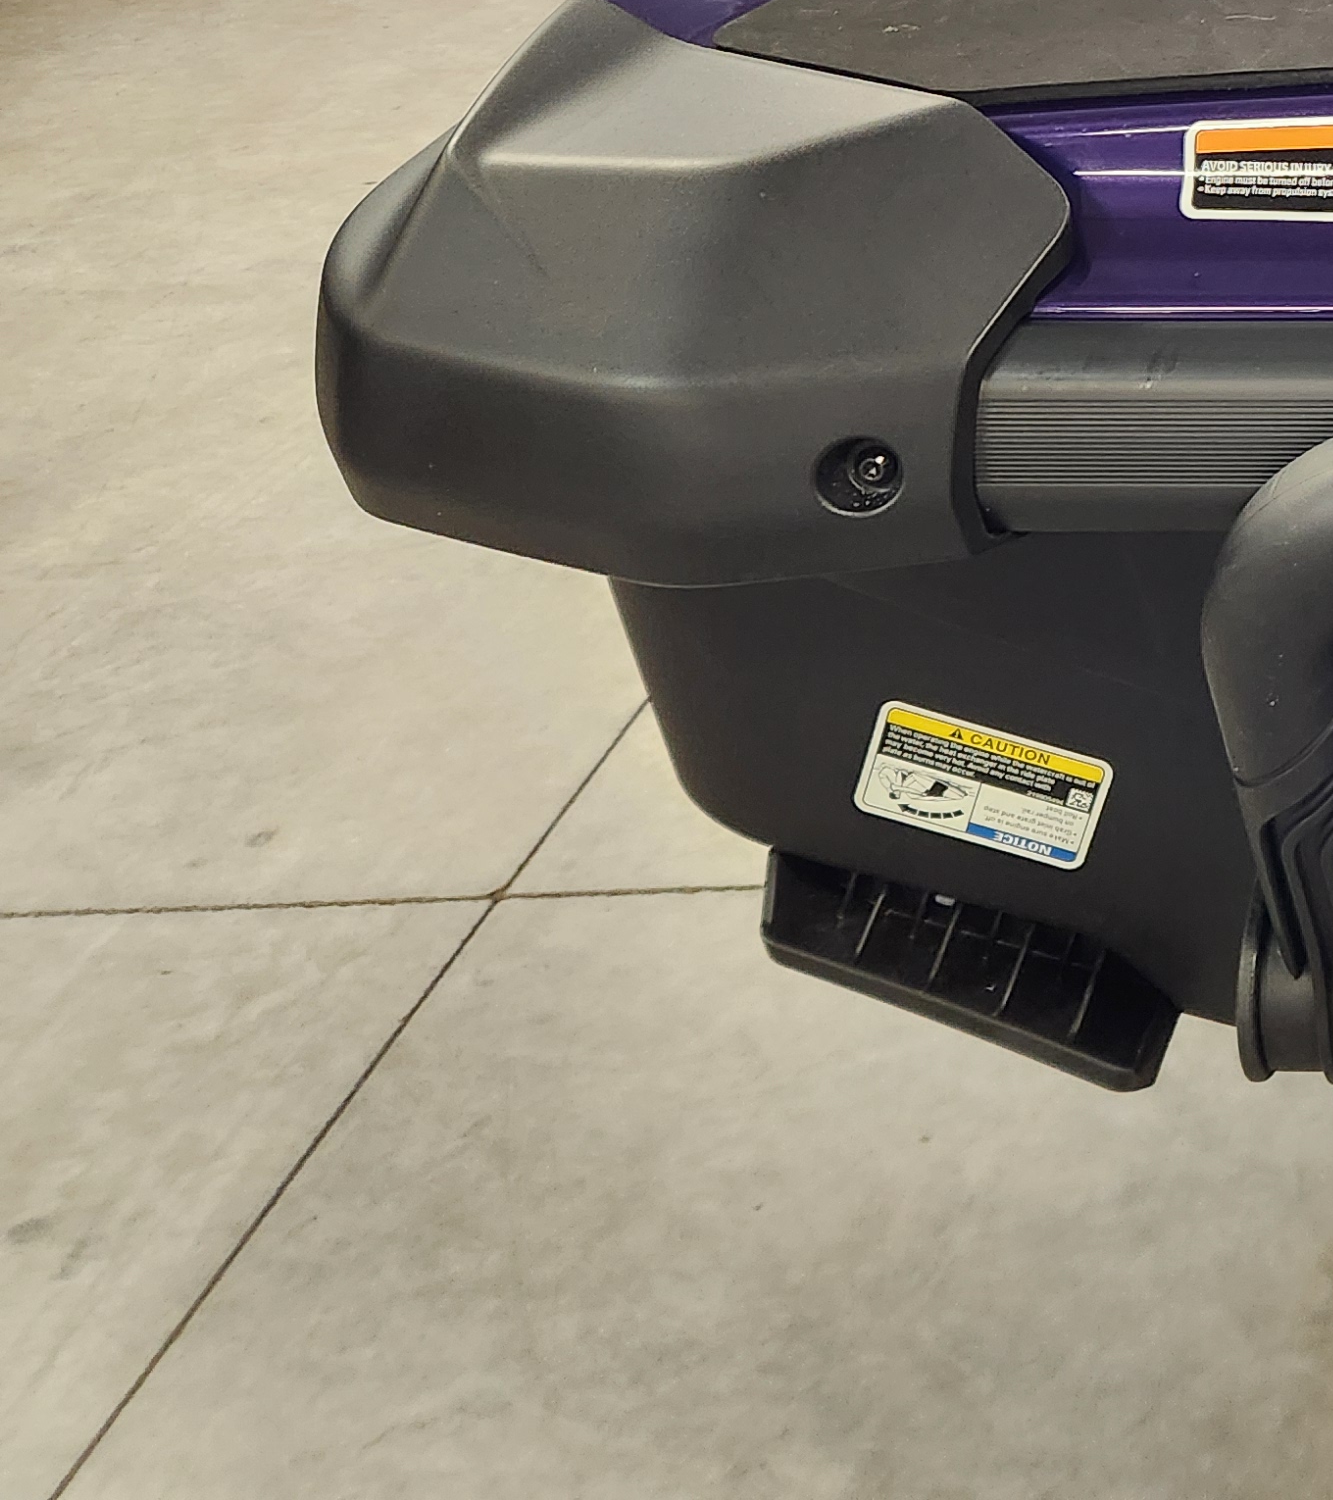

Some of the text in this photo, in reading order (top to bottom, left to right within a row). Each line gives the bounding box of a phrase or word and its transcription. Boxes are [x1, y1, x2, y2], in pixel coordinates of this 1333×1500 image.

[1201, 160, 1239, 173] AVOID
[1240, 161, 1288, 173] SERIOUS
[1206, 176, 1234, 186] Engine
[1298, 178, 1310, 186] off
[1204, 185, 1226, 195] Keep
[1228, 187, 1250, 196] away
[1252, 186, 1272, 194] from
[1272, 186, 1317, 197] propulsion
[970, 734, 1051, 766] CAUTION
[882, 746, 976, 778] plate as burns may occur.
[888, 732, 900, 740] the
[900, 736, 924, 748] water,
[925, 742, 938, 752] the
[939, 746, 957, 756] heat
[957, 752, 998, 768] exchanger
[1006, 766, 1020, 774] the
[1020, 770, 1036, 780] ride
[1036, 774, 1056, 786] plate
[890, 724, 912, 736] When
[913, 730, 950, 748] operating
[950, 742, 964, 751] the
[964, 746, 990, 759] engine
[990, 754, 1012, 764] while
[1012, 760, 1026, 768] the
[1026, 764, 1066, 781] watercraft
[1074, 778, 1086, 787] out
[1086, 781, 1096, 789] of
[884, 738, 1052, 792] may become very hot. Avoid any contact with
[983, 805, 1000, 816] step
[1021, 807, 1036, 817] rail.
[1046, 806, 1062, 816] boat
[984, 814, 996, 822] off.
[1018, 815, 1036, 826] grate
[1036, 811, 1064, 826] bumper
[1006, 822, 1030, 834] engine
[1038, 820, 1054, 830] inlet
[1031, 830, 1048, 838] sure
[1054, 826, 1072, 836] Grab
[993, 832, 1052, 856] NOTICE
[1050, 834, 1069, 845] Make
